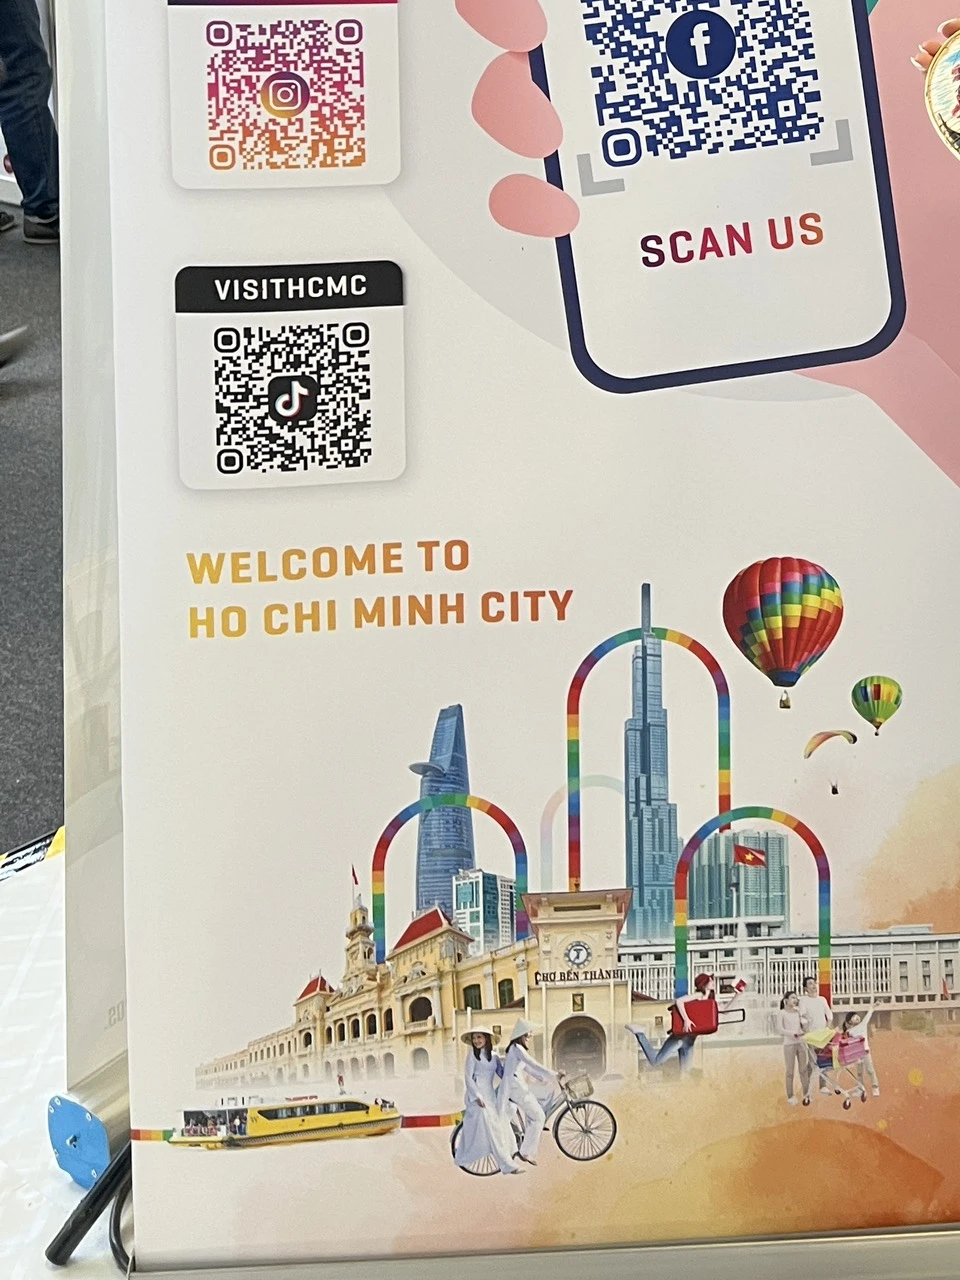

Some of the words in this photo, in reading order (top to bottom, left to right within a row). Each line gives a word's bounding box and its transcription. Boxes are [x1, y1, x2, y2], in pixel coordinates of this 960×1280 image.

[641, 222, 752, 267] SCAN
[768, 213, 823, 249] US
[215, 275, 366, 300] VISITHCMC
[187, 542, 403, 584] WELCOME
[417, 540, 469, 571] TO
[189, 606, 246, 638] HO
[264, 600, 336, 635] CHI
[355, 593, 464, 628] MINH
[482, 590, 573, 622] CITY
